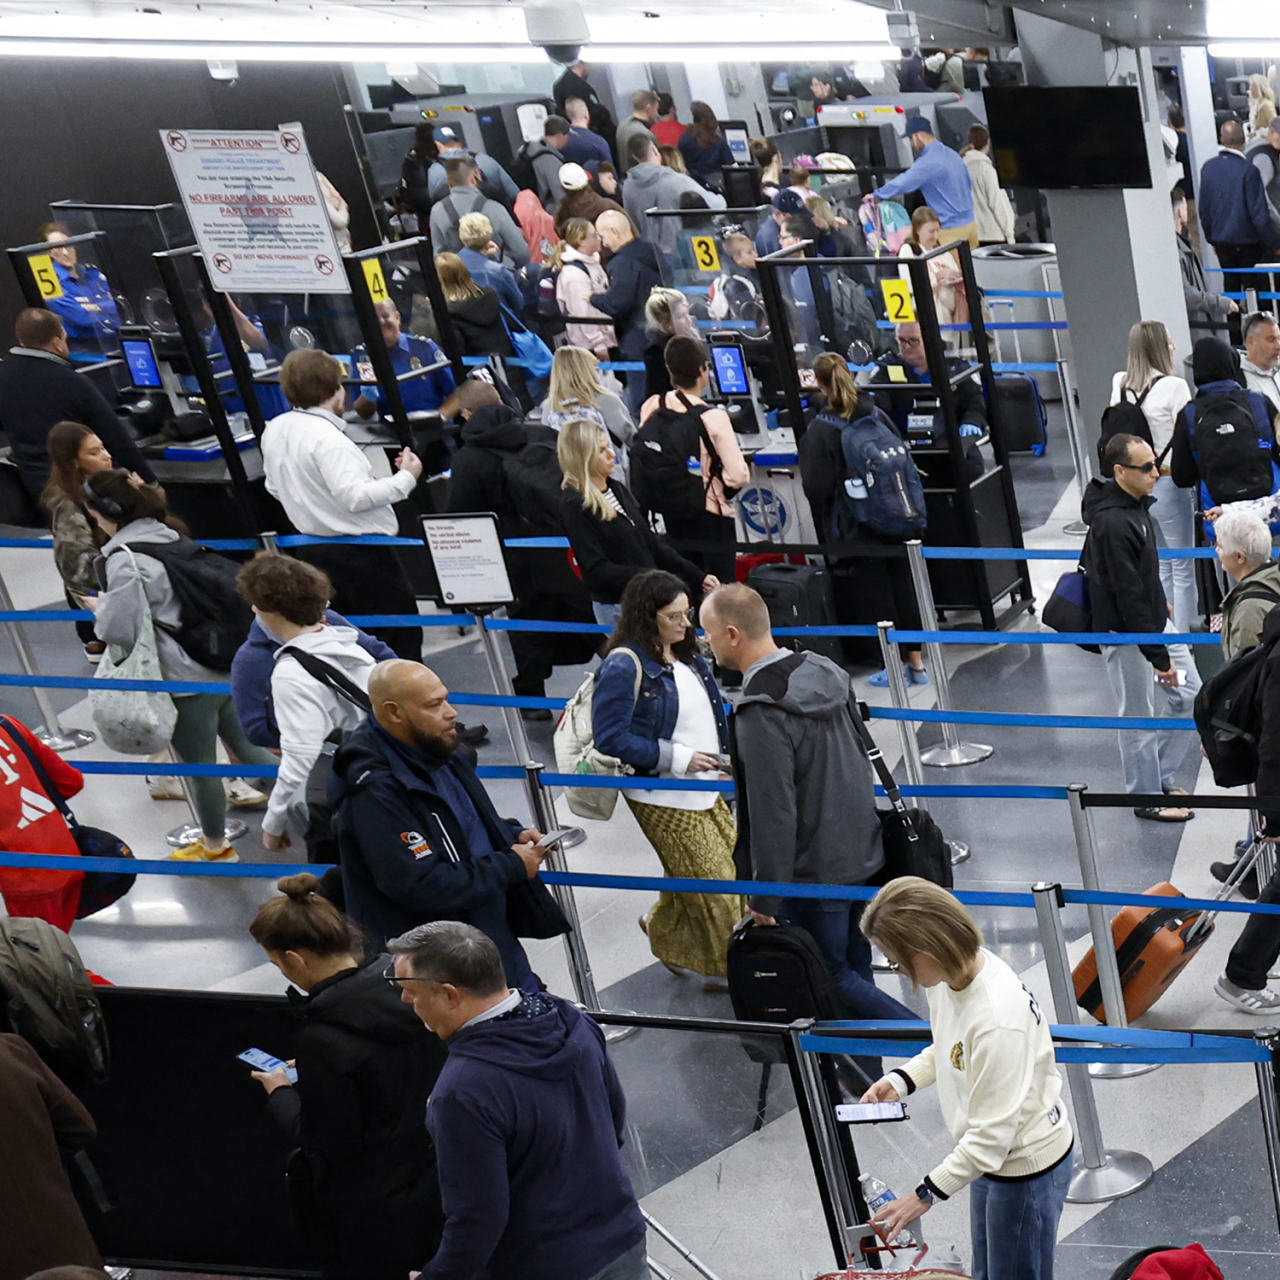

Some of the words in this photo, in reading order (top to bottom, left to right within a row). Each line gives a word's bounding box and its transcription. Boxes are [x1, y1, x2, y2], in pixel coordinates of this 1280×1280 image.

[210, 138, 263, 149] ATTENTION
[189, 194, 201, 202] NO
[203, 194, 249, 203] FIREARMS
[250, 194, 269, 203] ARE
[272, 195, 316, 204] ALLOWED
[219, 208, 242, 216] PAST
[267, 208, 292, 217] POINT
[697, 240, 714, 267] 3
[37, 268, 56, 296] 5
[373, 272, 384, 298] 4
[889, 293, 909, 319] 2
